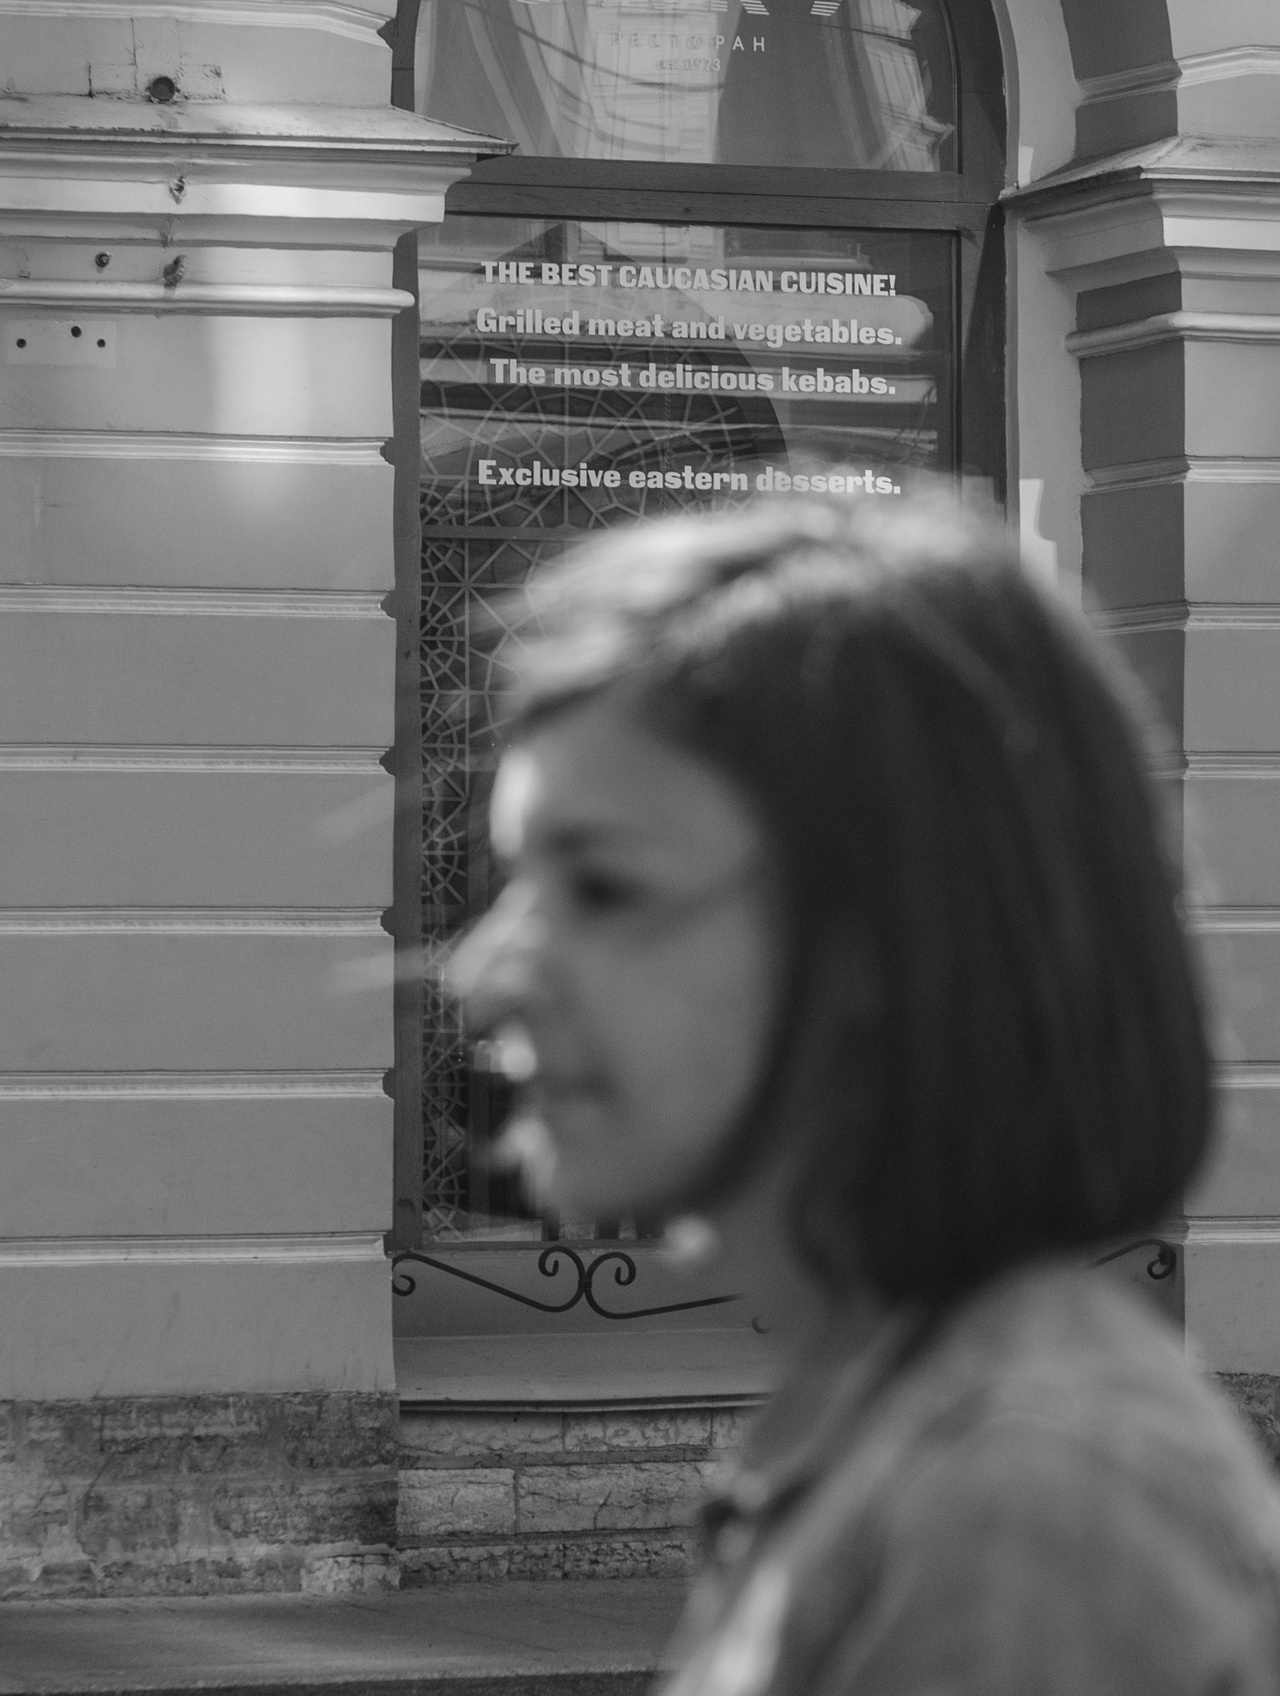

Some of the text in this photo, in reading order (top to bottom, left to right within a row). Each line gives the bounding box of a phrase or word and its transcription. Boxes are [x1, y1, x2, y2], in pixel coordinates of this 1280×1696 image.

[481, 262, 897, 296] THE BEST CAUCASIAN CUISINE!
[476, 307, 902, 348] Grilled meat and vegetables.
[490, 358, 896, 395] The most delicious kebabs.
[478, 460, 901, 494] Exclusive eastern desserts.
